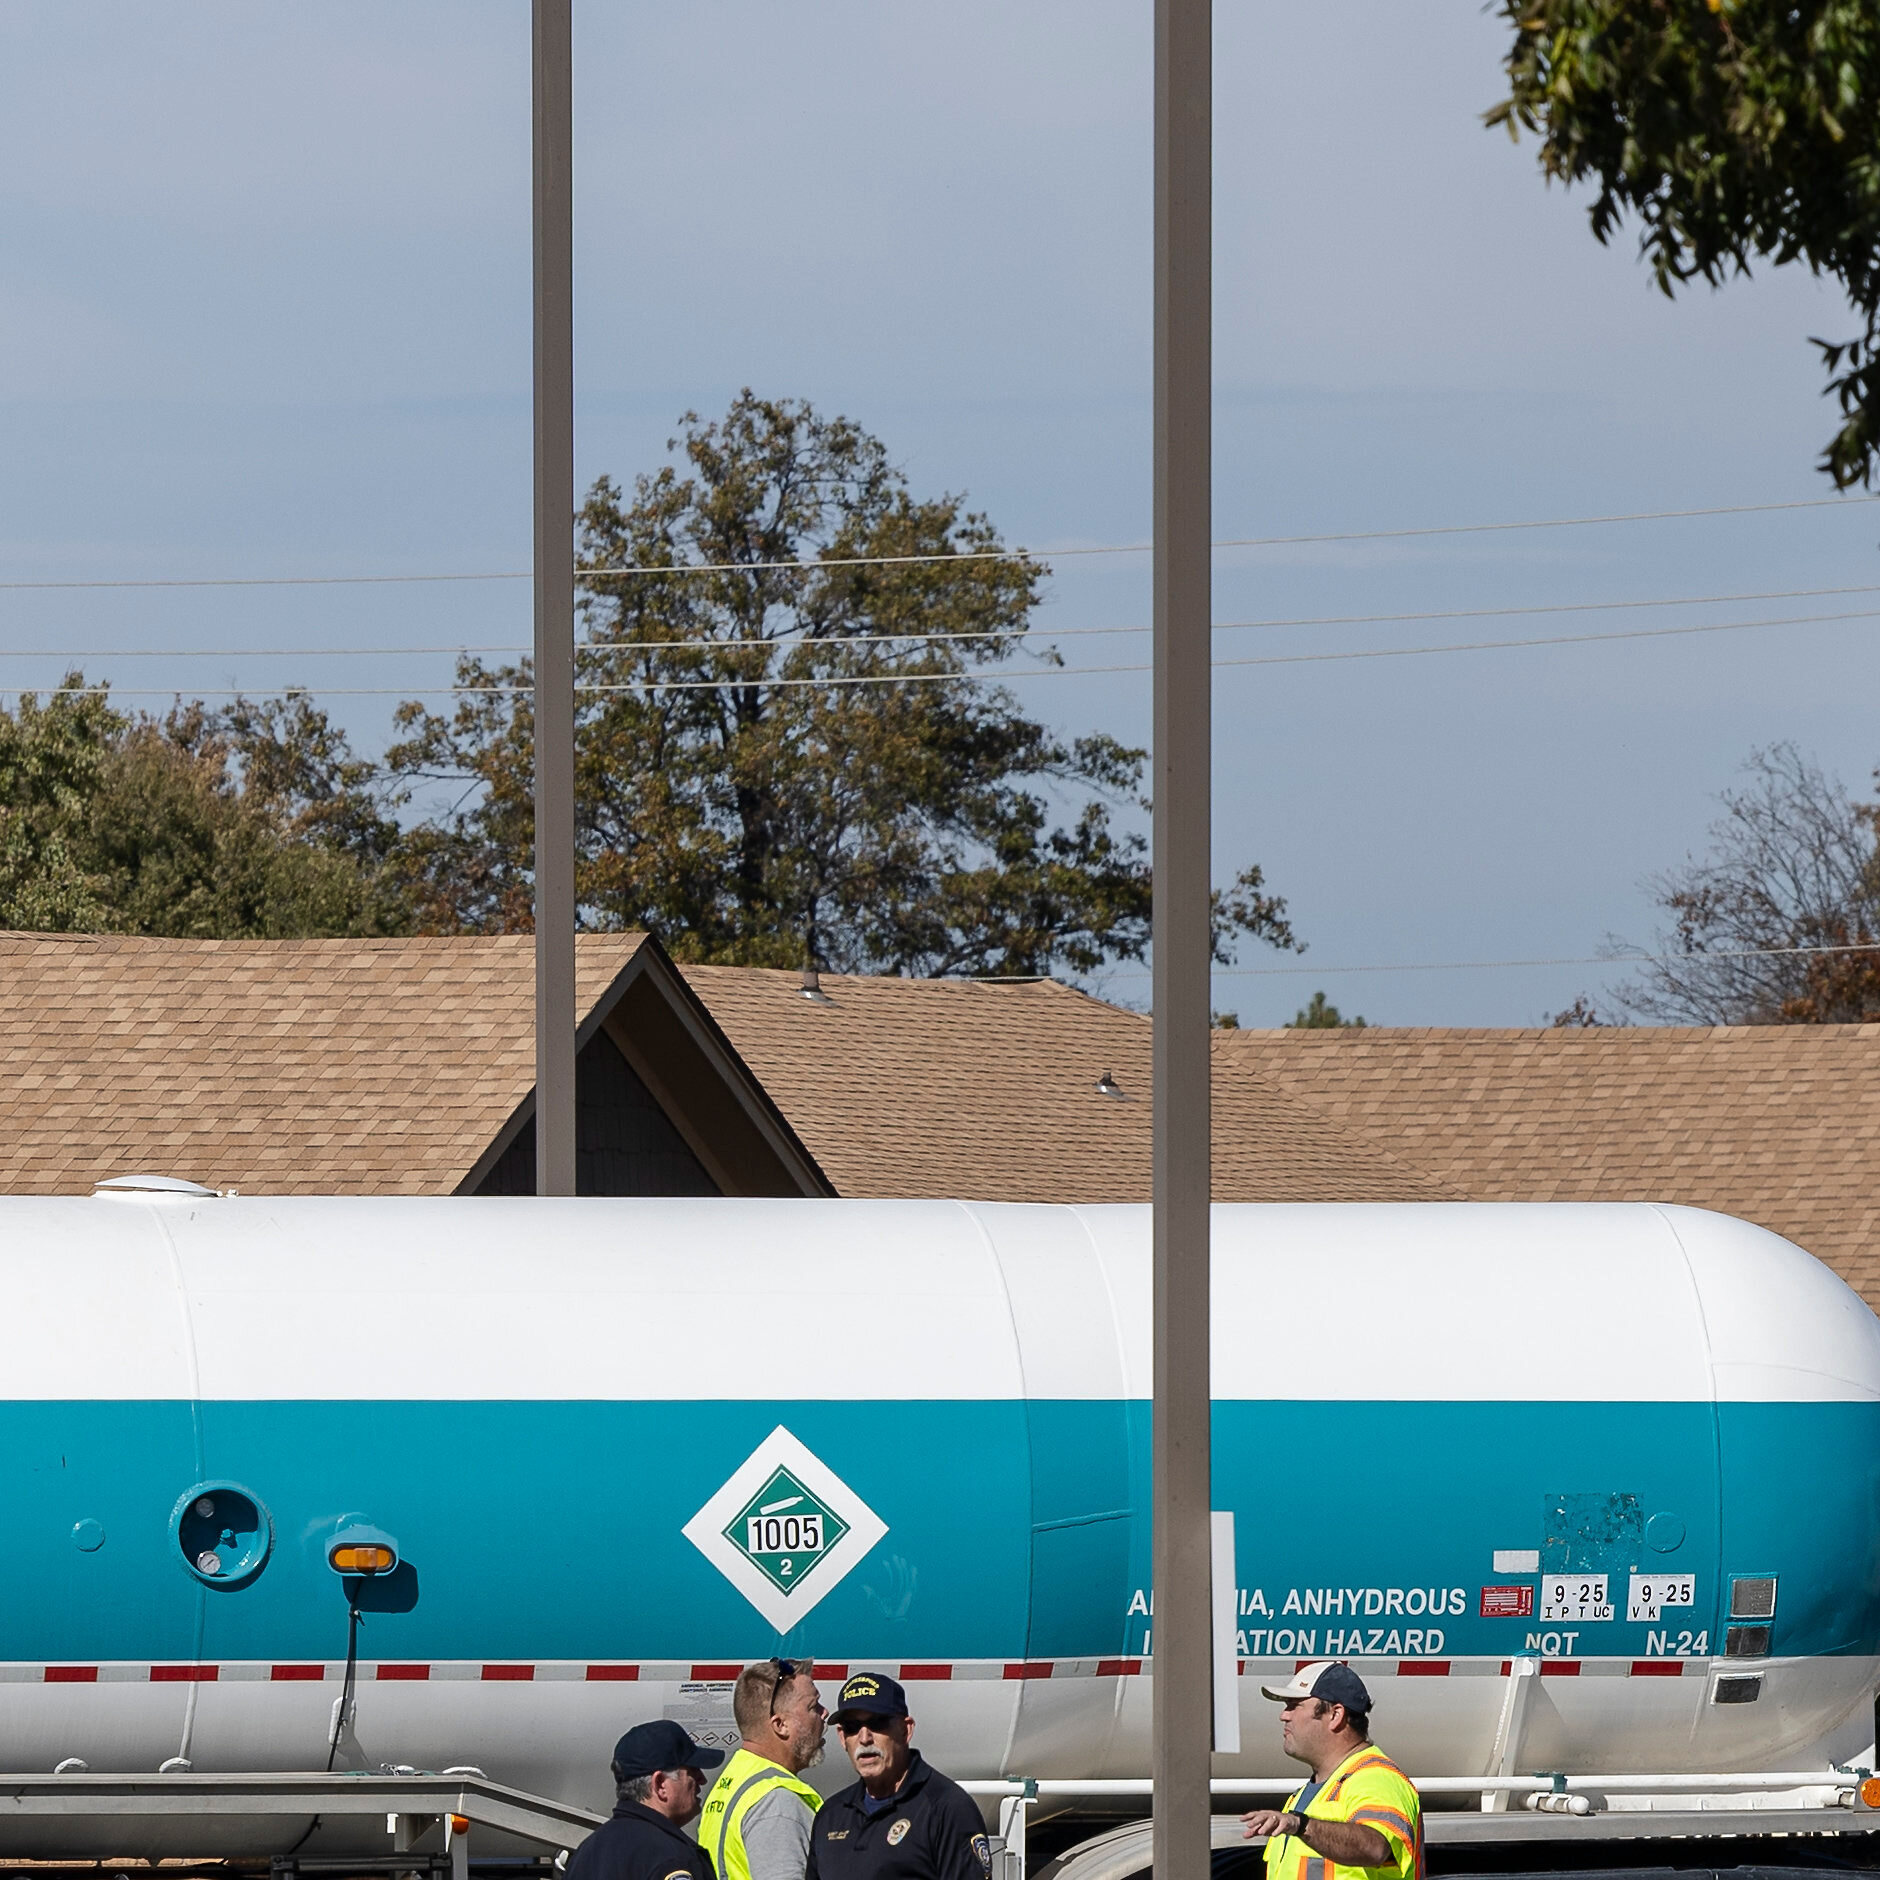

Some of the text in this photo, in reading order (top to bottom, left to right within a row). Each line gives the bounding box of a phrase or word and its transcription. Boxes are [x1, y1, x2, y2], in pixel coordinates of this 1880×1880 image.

[751, 1517, 819, 1551] 1005
[780, 1558, 792, 1576] 2
[1282, 1588, 1467, 1616] ANHYDROUS
[1561, 1606, 1570, 1619] P
[1579, 1606, 1586, 1618] T
[1593, 1605, 1610, 1618] UC
[1632, 1606, 1656, 1618] V K
[1142, 1629, 1445, 1655] IATION HAZARD
[1525, 1630, 1709, 1657] NQT N-24
